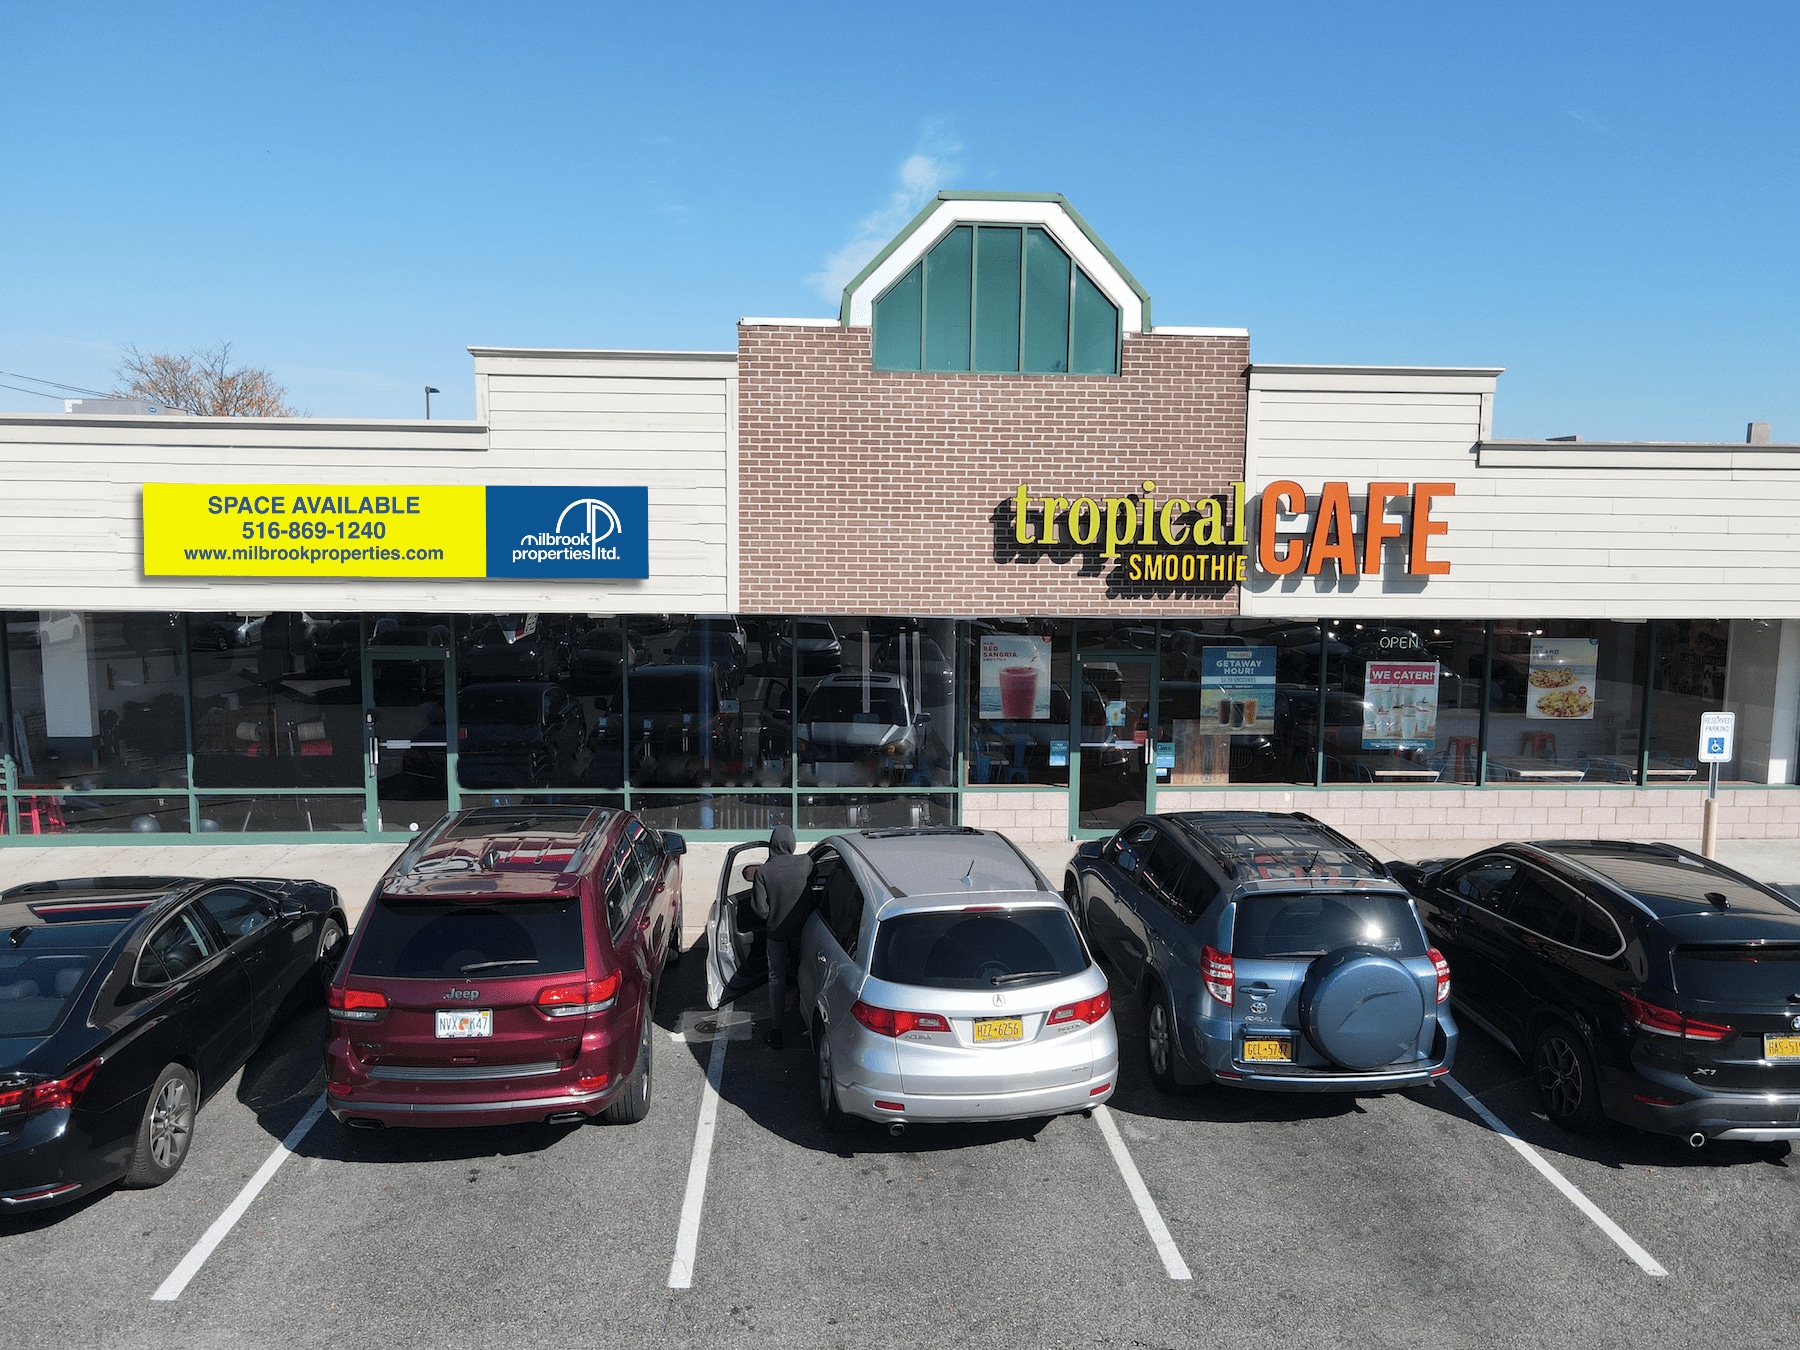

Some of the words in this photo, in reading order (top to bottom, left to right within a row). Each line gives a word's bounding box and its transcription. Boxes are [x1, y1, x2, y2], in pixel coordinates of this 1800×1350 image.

[208, 496, 287, 515] SPACE
[291, 496, 420, 515] AVAILABLE
[1013, 480, 1248, 558] tropical
[241, 521, 386, 540] 516-869-1240
[1258, 480, 1456, 575] CAFE
[521, 532, 590, 546] milbrook
[184, 545, 444, 563] www.milbrookproperties.com
[512, 547, 591, 563] properties
[597, 546, 621, 560] ltd.
[1129, 554, 1247, 582] SMOOTHIE
[1379, 636, 1419, 649] OPEN
[1216, 660, 1262, 668] GETAWAY
[1372, 670, 1391, 680] WE
[1393, 670, 1433, 680] CATER!
[445, 987, 479, 1001] Jeep
[440, 1017, 458, 1031] NVX
[469, 1017, 488, 1030] K47
[1693, 1068, 1717, 1076] X1
